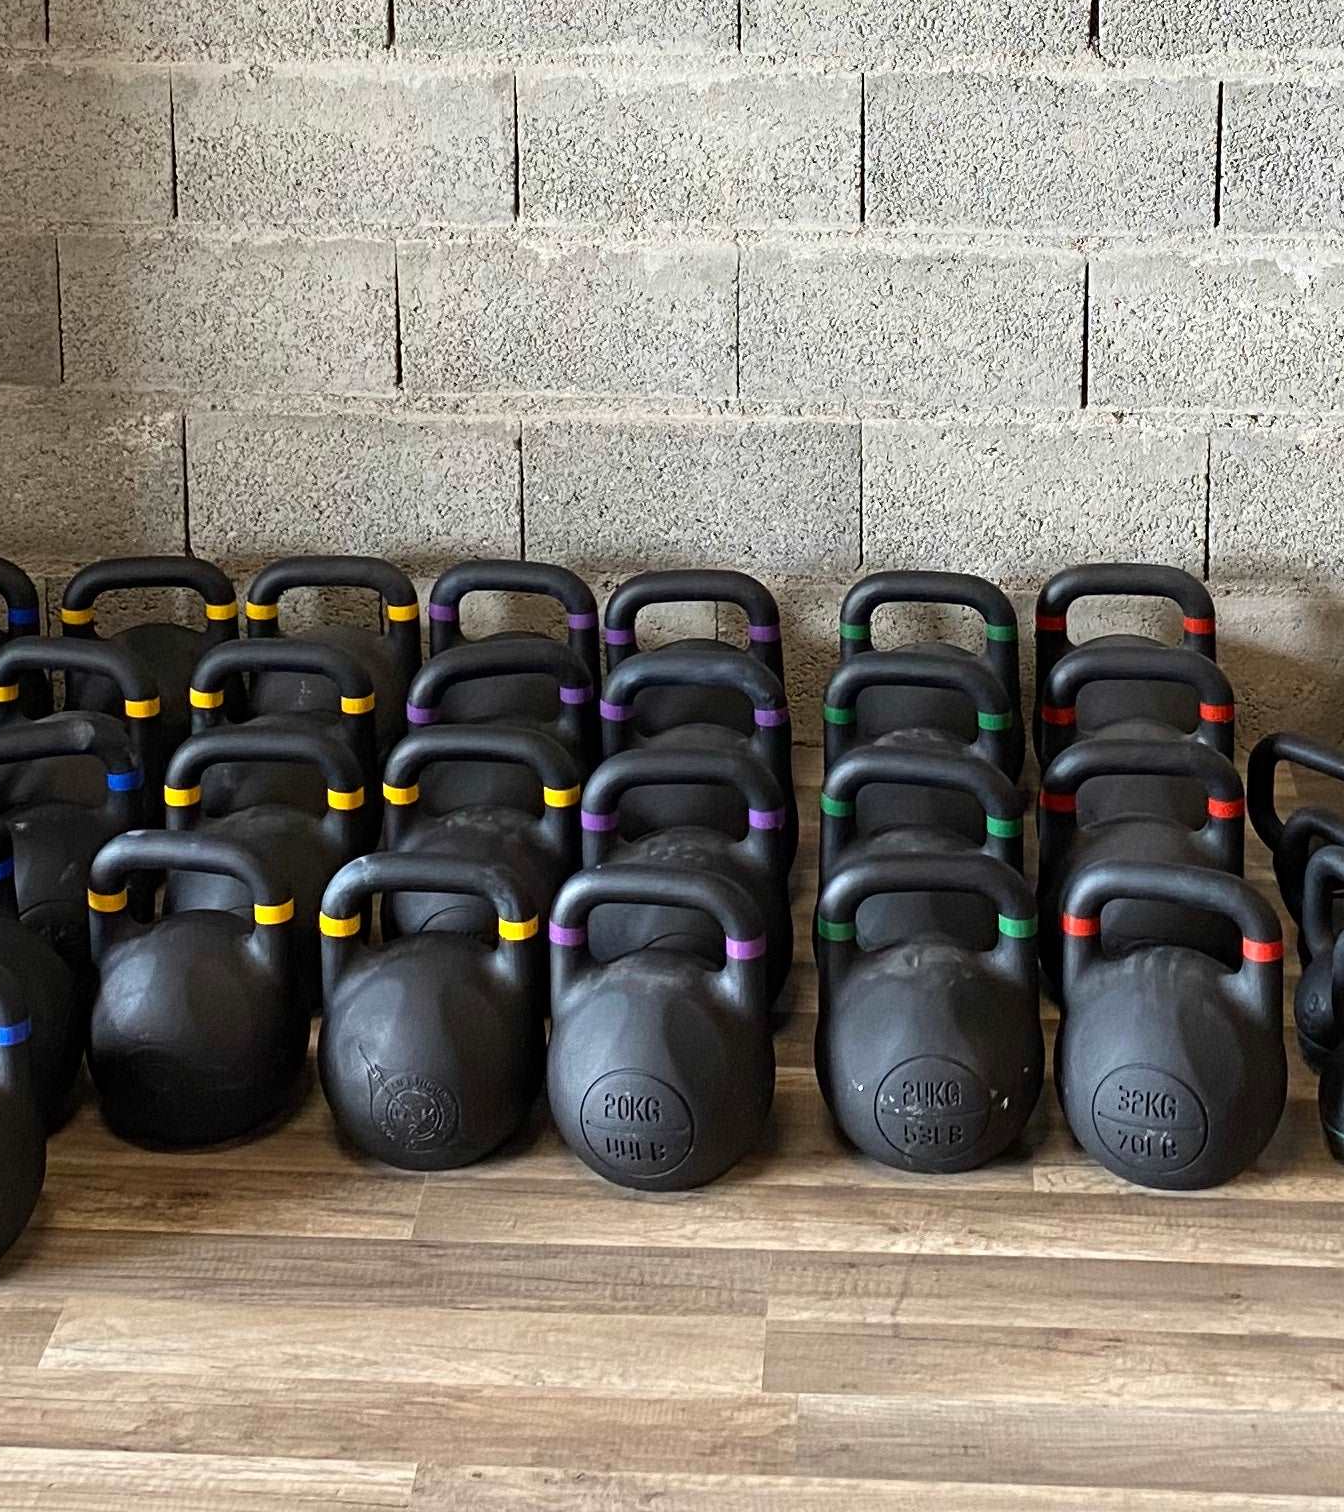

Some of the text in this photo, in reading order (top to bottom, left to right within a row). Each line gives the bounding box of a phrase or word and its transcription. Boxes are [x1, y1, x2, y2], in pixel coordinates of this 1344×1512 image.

[605, 1093, 662, 1122] 20KG
[903, 1081, 961, 1107] 24KG
[1119, 1085, 1177, 1120] 32KG
[904, 1125, 964, 1144] 53LB
[1118, 1130, 1177, 1159] 70LB
